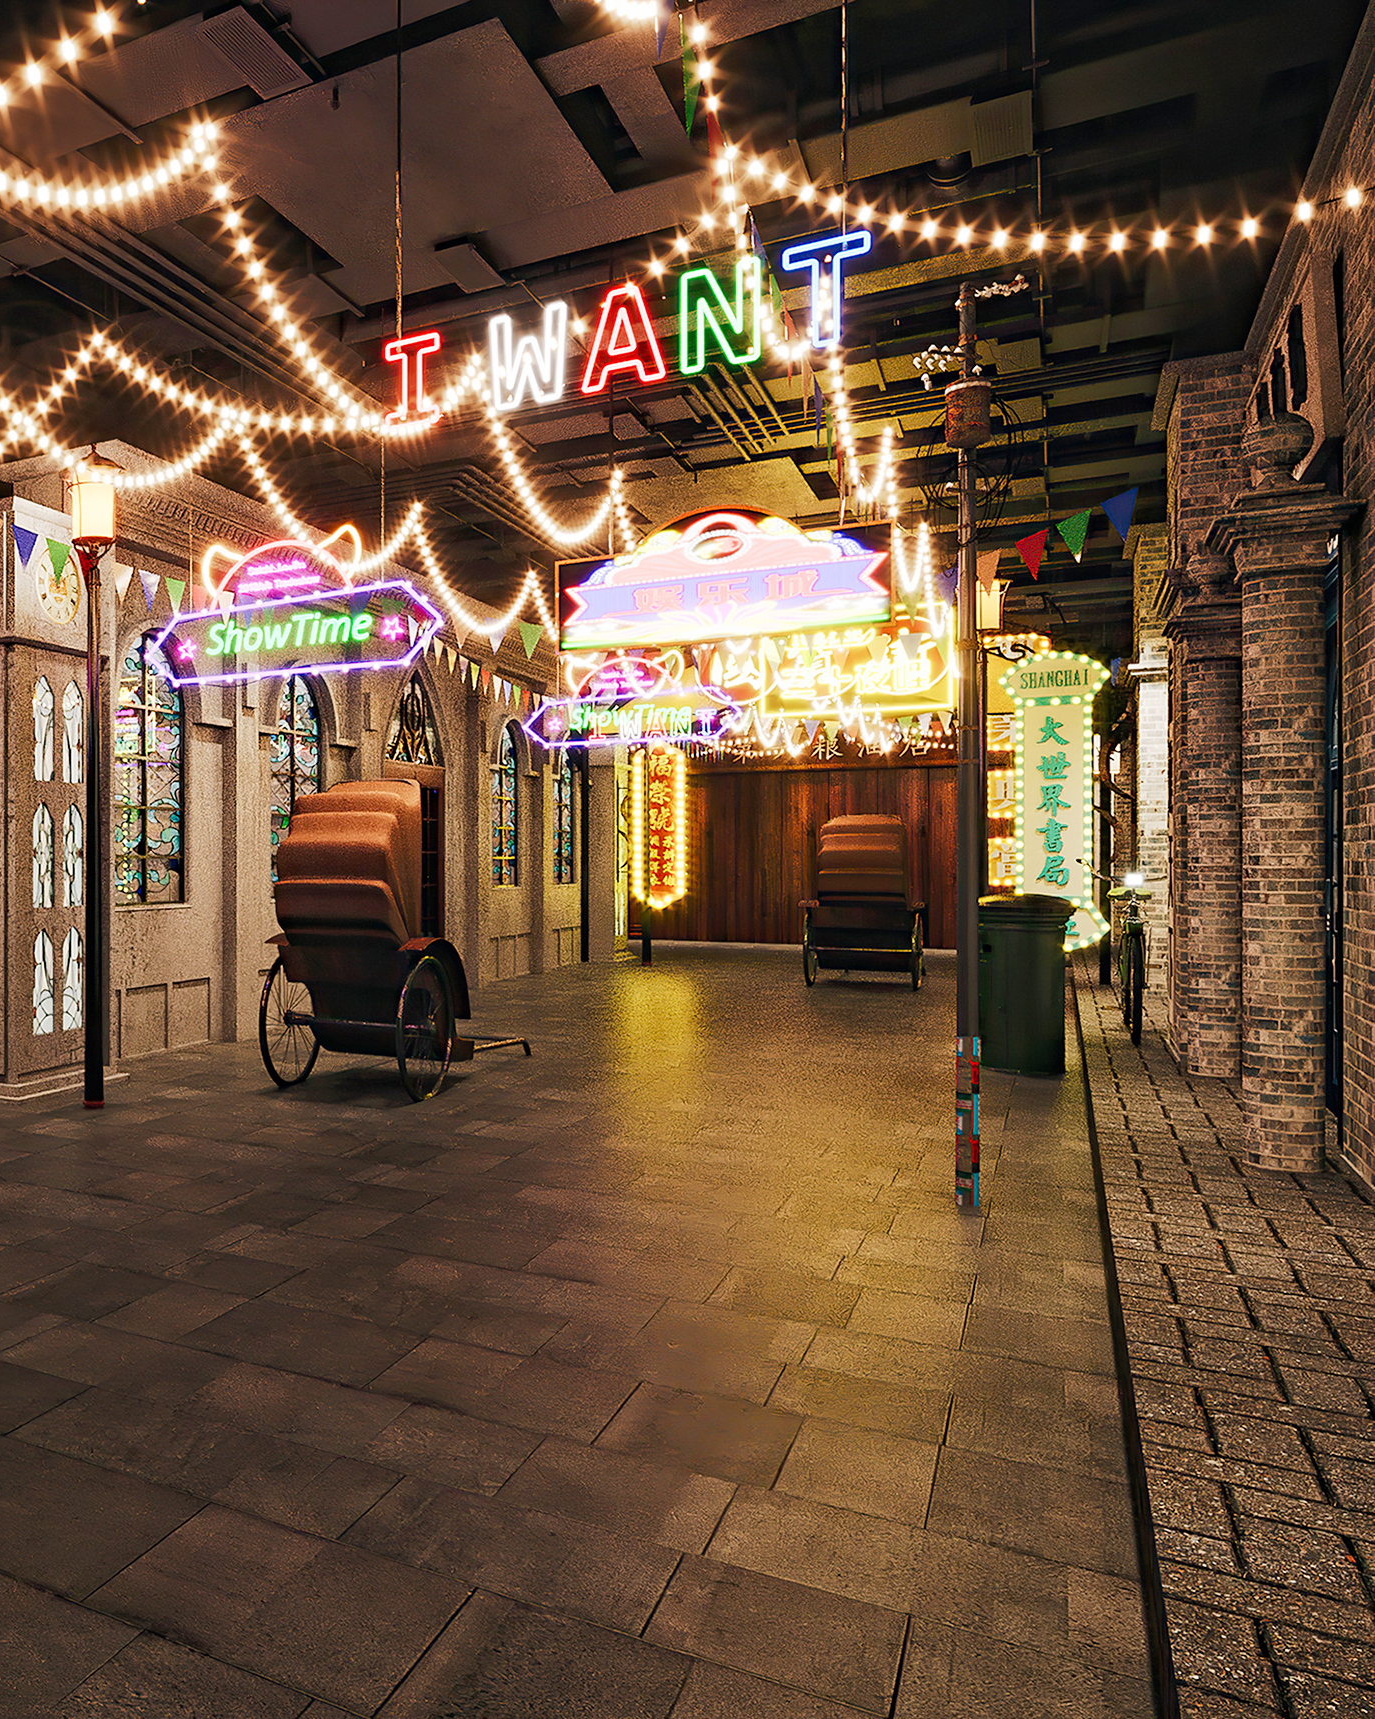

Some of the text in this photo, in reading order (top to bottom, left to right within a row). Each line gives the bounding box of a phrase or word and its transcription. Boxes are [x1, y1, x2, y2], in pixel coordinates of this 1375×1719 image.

[383, 229, 872, 432] I WANT
[633, 569, 825, 613] 娱乐城
[205, 610, 374, 657] ShowTime
[1020, 668, 1090, 691] SHANGHAI
[1035, 715, 1072, 888] 大世界書局
